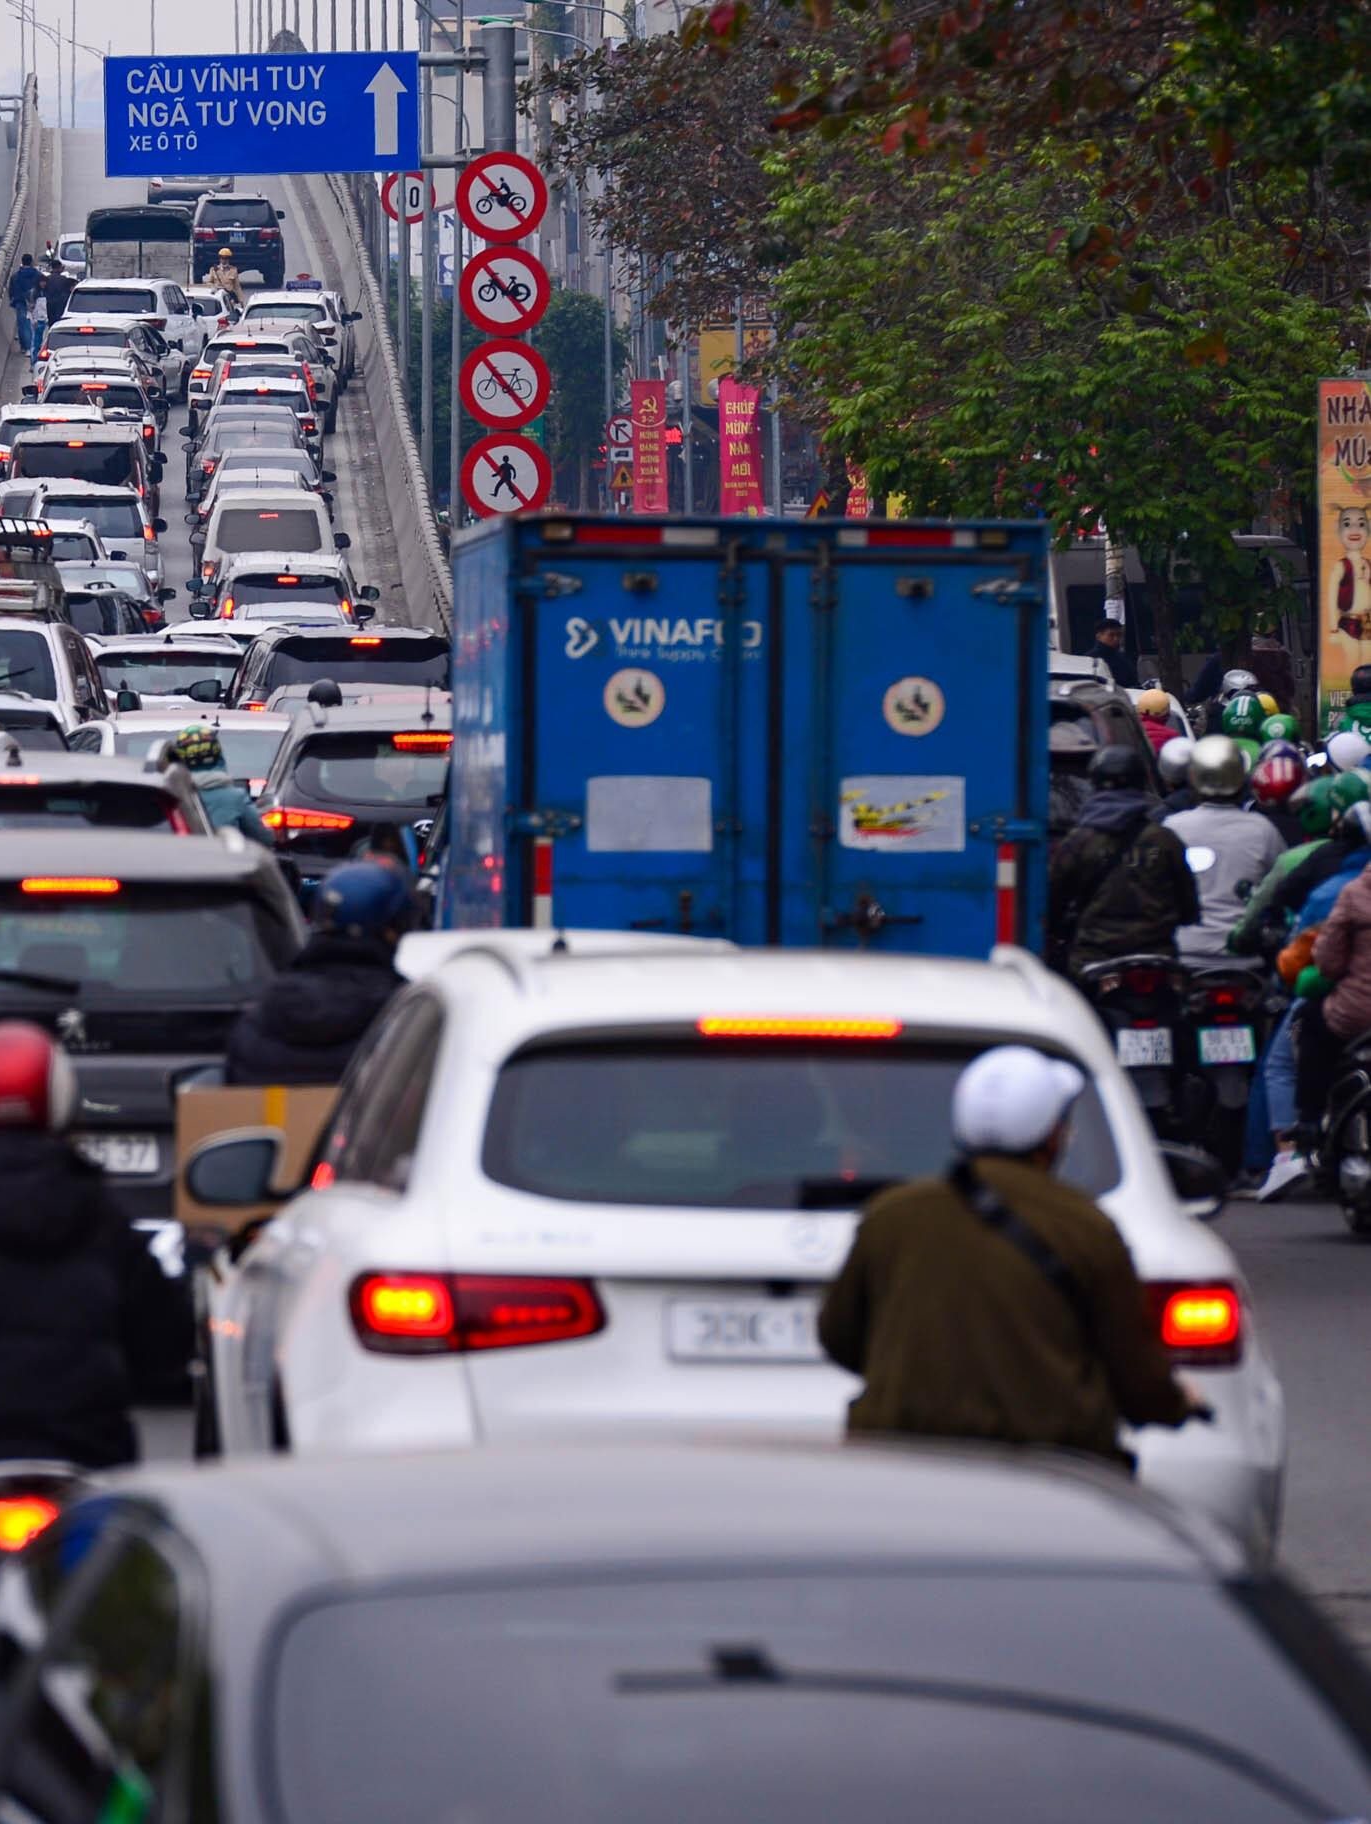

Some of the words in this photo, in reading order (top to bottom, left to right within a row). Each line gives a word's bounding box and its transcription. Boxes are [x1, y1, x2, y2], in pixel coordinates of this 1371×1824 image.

[125, 61, 183, 94] CẦU
[191, 62, 259, 93] VĨNH
[266, 65, 327, 92] TUY
[128, 95, 190, 128] NGÃ
[196, 99, 238, 127] TƯ
[246, 100, 327, 132] VỌNG
[129, 135, 153, 152] XE
[157, 131, 169, 151] Ô
[173, 131, 198, 151] TÔ
[1334, 433, 1371, 467] MÚ
